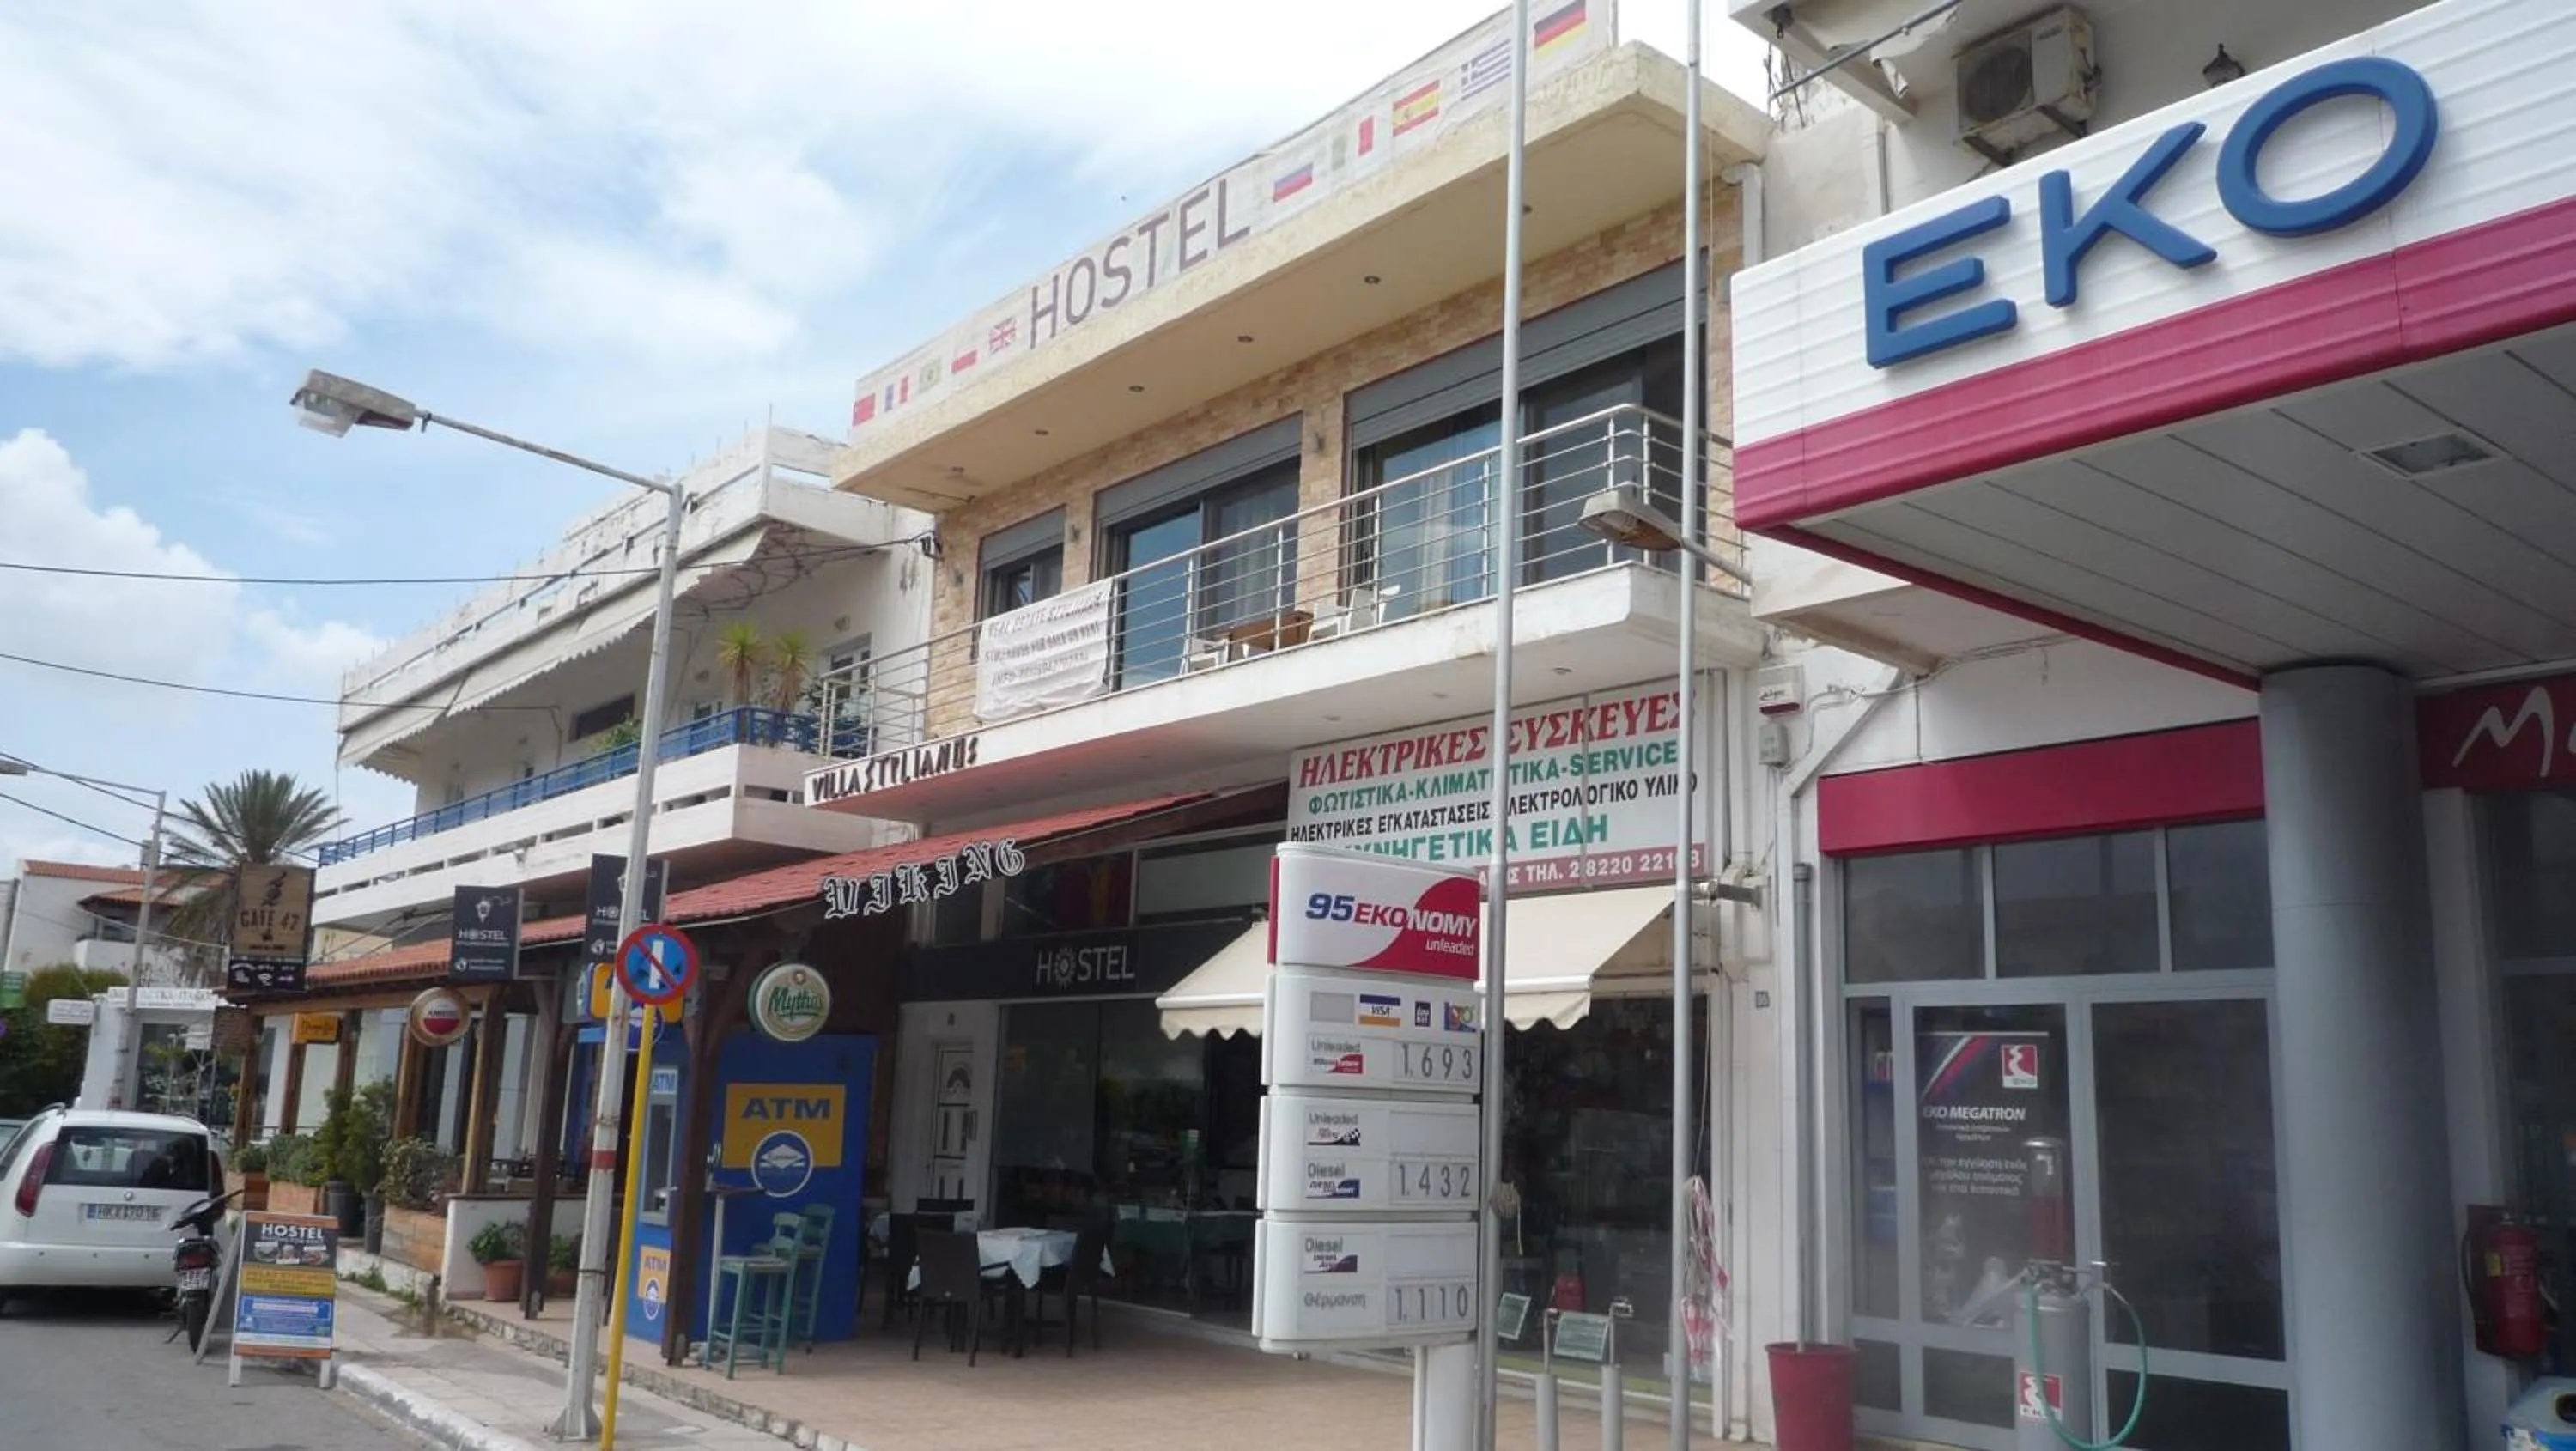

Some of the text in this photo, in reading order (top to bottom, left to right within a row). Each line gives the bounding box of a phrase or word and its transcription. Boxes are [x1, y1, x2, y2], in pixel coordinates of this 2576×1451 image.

[1863, 55, 2439, 369] EKO
[1030, 178, 1251, 349] HOSTEL
[2452, 686, 2576, 777] M
[1298, 726, 1489, 788] ΗΛΕΚΤΡΙΚΕΣ
[812, 767, 861, 801] VILLA
[1291, 817, 1373, 842] ΗΛΕΚΤΡΙΚΕΣ
[1378, 800, 1491, 834] ΕΓΚΑΤΑΣΤΑΣΕΙΣ
[1508, 779, 1638, 817] ΛΕΚΤΡΟΛΟΓΙΚΟ
[1346, 813, 1608, 861] ΝΗΓΕΤΙΚΑ ΕΙΔΗ
[824, 837, 1025, 920] VIKING
[1527, 864, 1564, 885] ΤΗΛ.
[596, 906, 651, 921] HOL
[458, 928, 509, 941] HOSTEL
[1425, 938, 1474, 956] unleaded
[1036, 945, 1135, 989] HOSTEL
[768, 986, 824, 1021] Mythos
[1401, 1044, 1473, 1080] 1.693
[741, 1097, 831, 1120] ATM
[1309, 1113, 1358, 1125] Unleaded
[1949, 1106, 2026, 1121] MEGATRON
[1308, 1163, 1471, 1198] Diesel 1.432
[262, 1223, 323, 1240] HOSTEL
[1304, 1236, 1344, 1253] Diesel
[1395, 1286, 1469, 1321] 1.110
